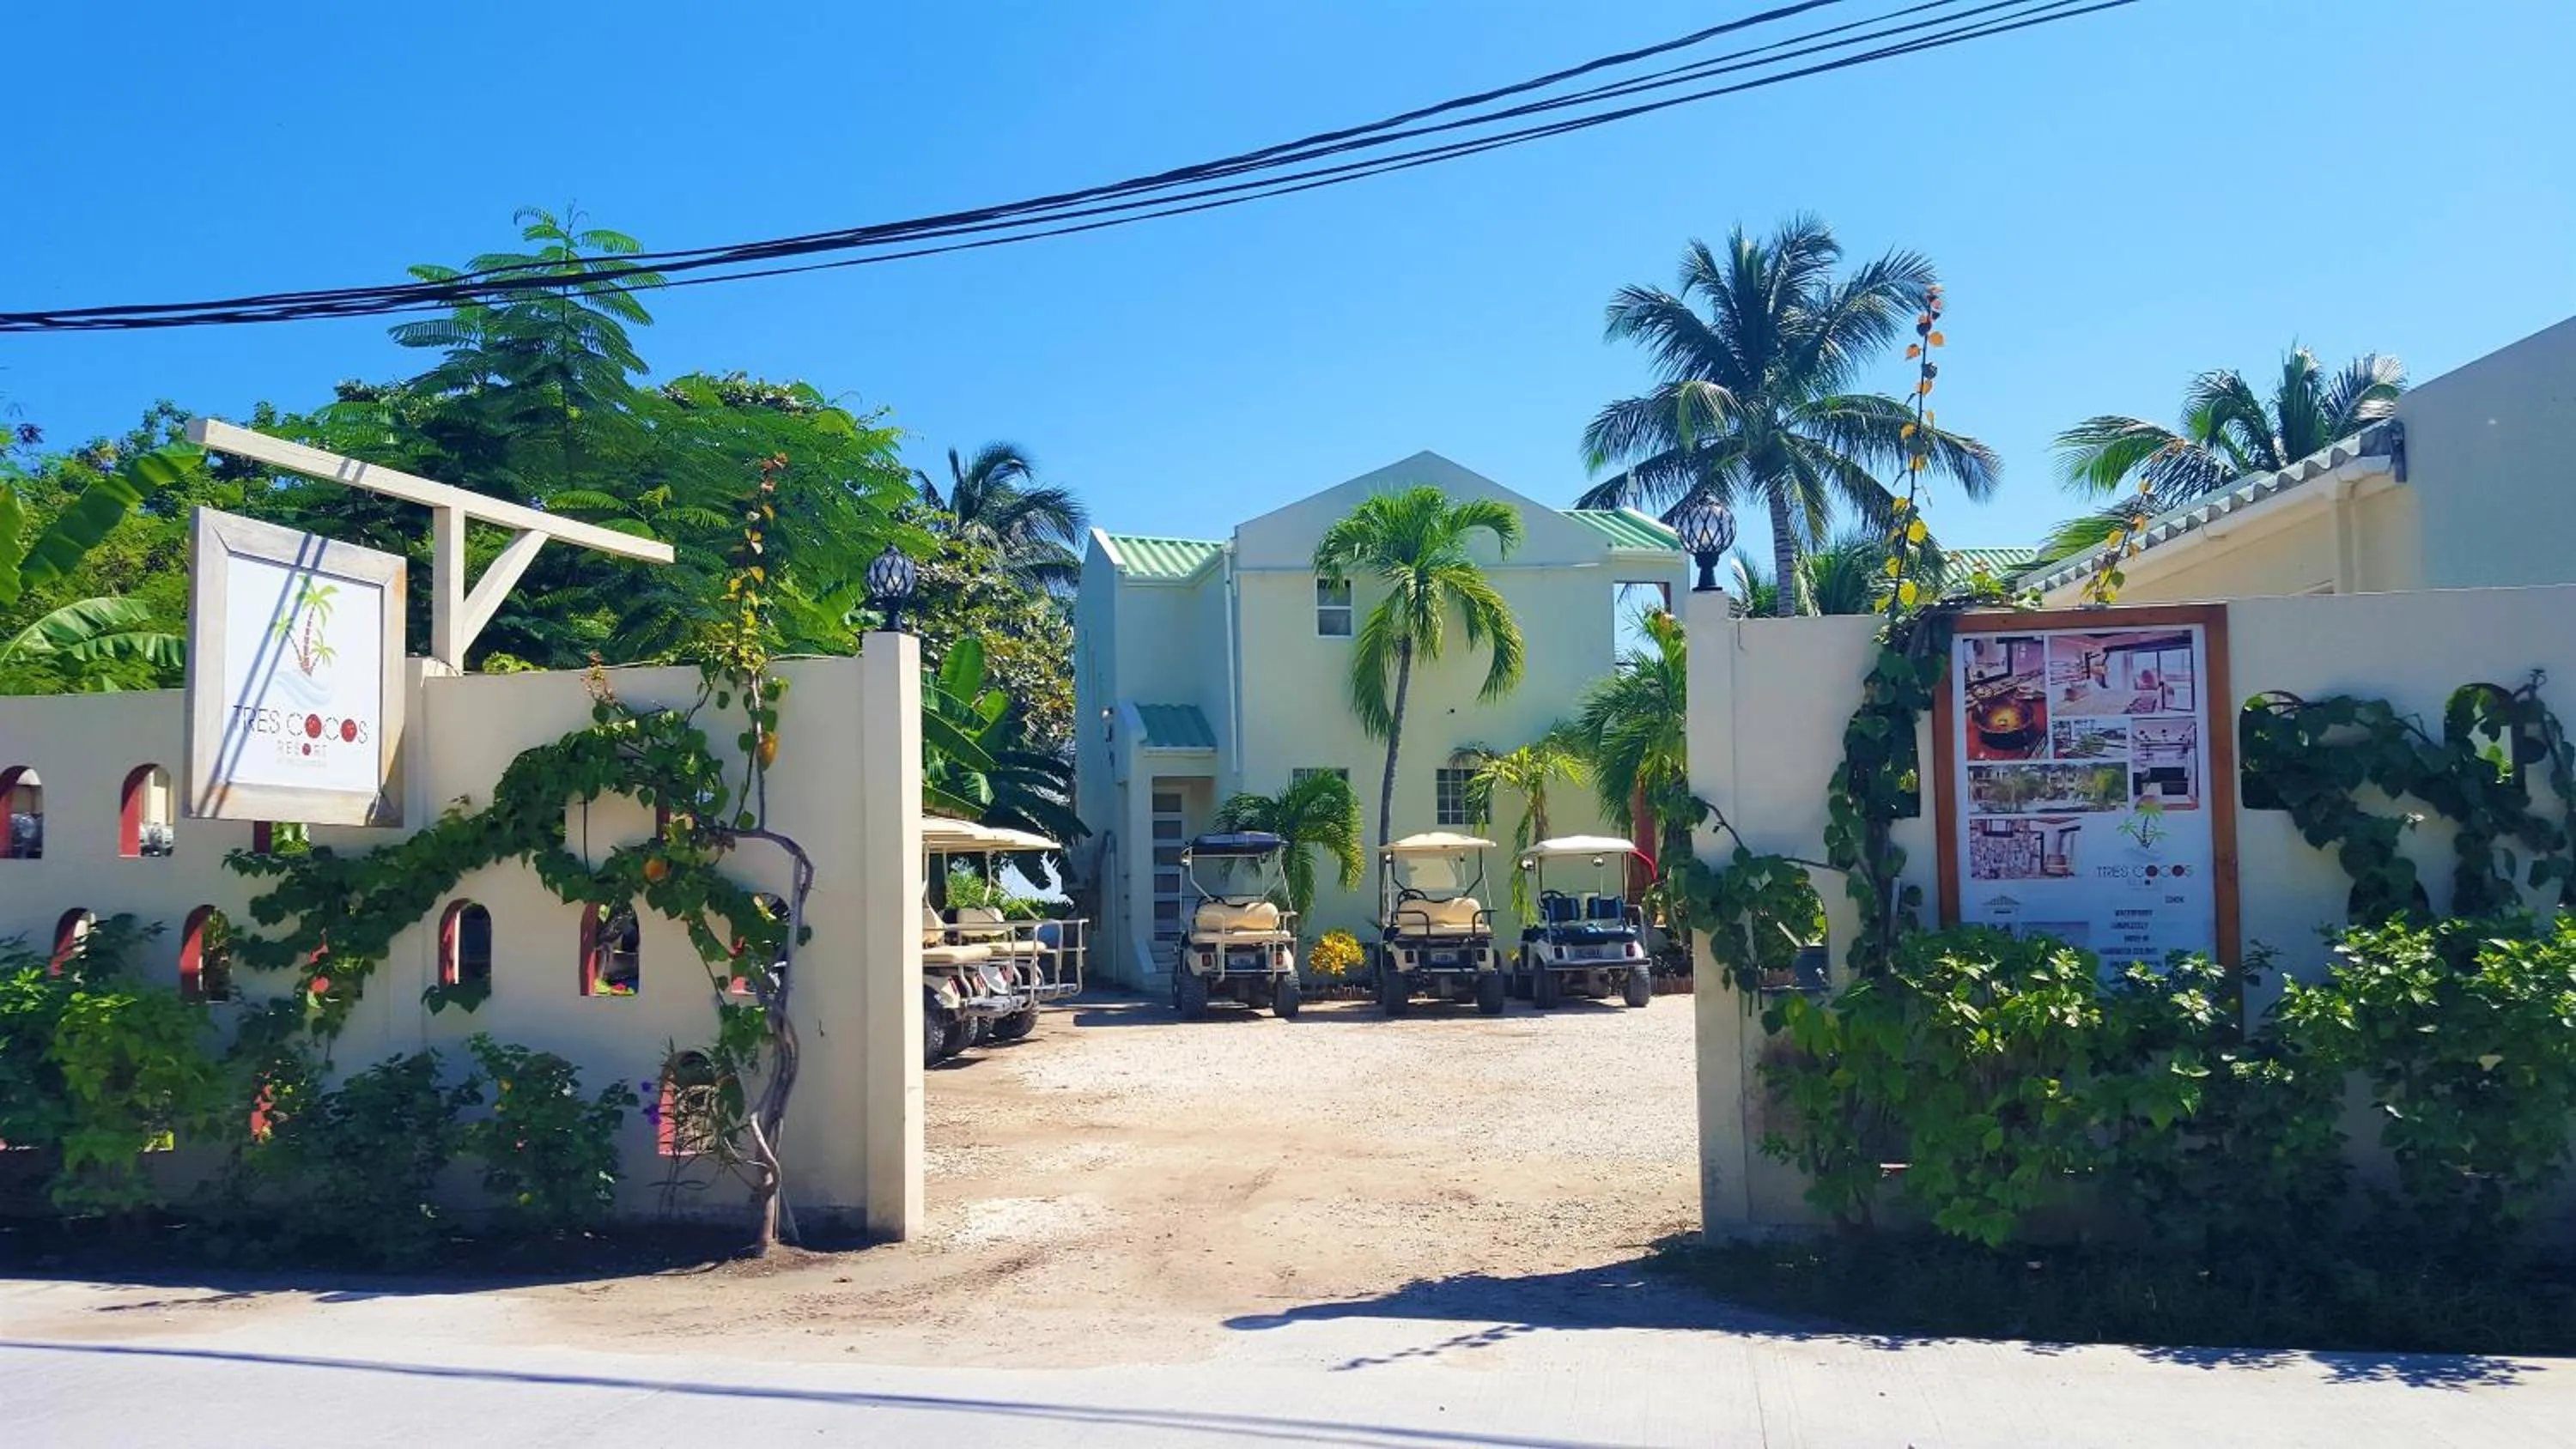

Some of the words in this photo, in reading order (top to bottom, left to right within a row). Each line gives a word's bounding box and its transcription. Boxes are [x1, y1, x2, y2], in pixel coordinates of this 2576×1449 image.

[233, 705, 281, 734] TRES
[286, 712, 368, 744] COCOS
[2097, 865, 2129, 877] TRES
[2133, 864, 2194, 877] COCOS
